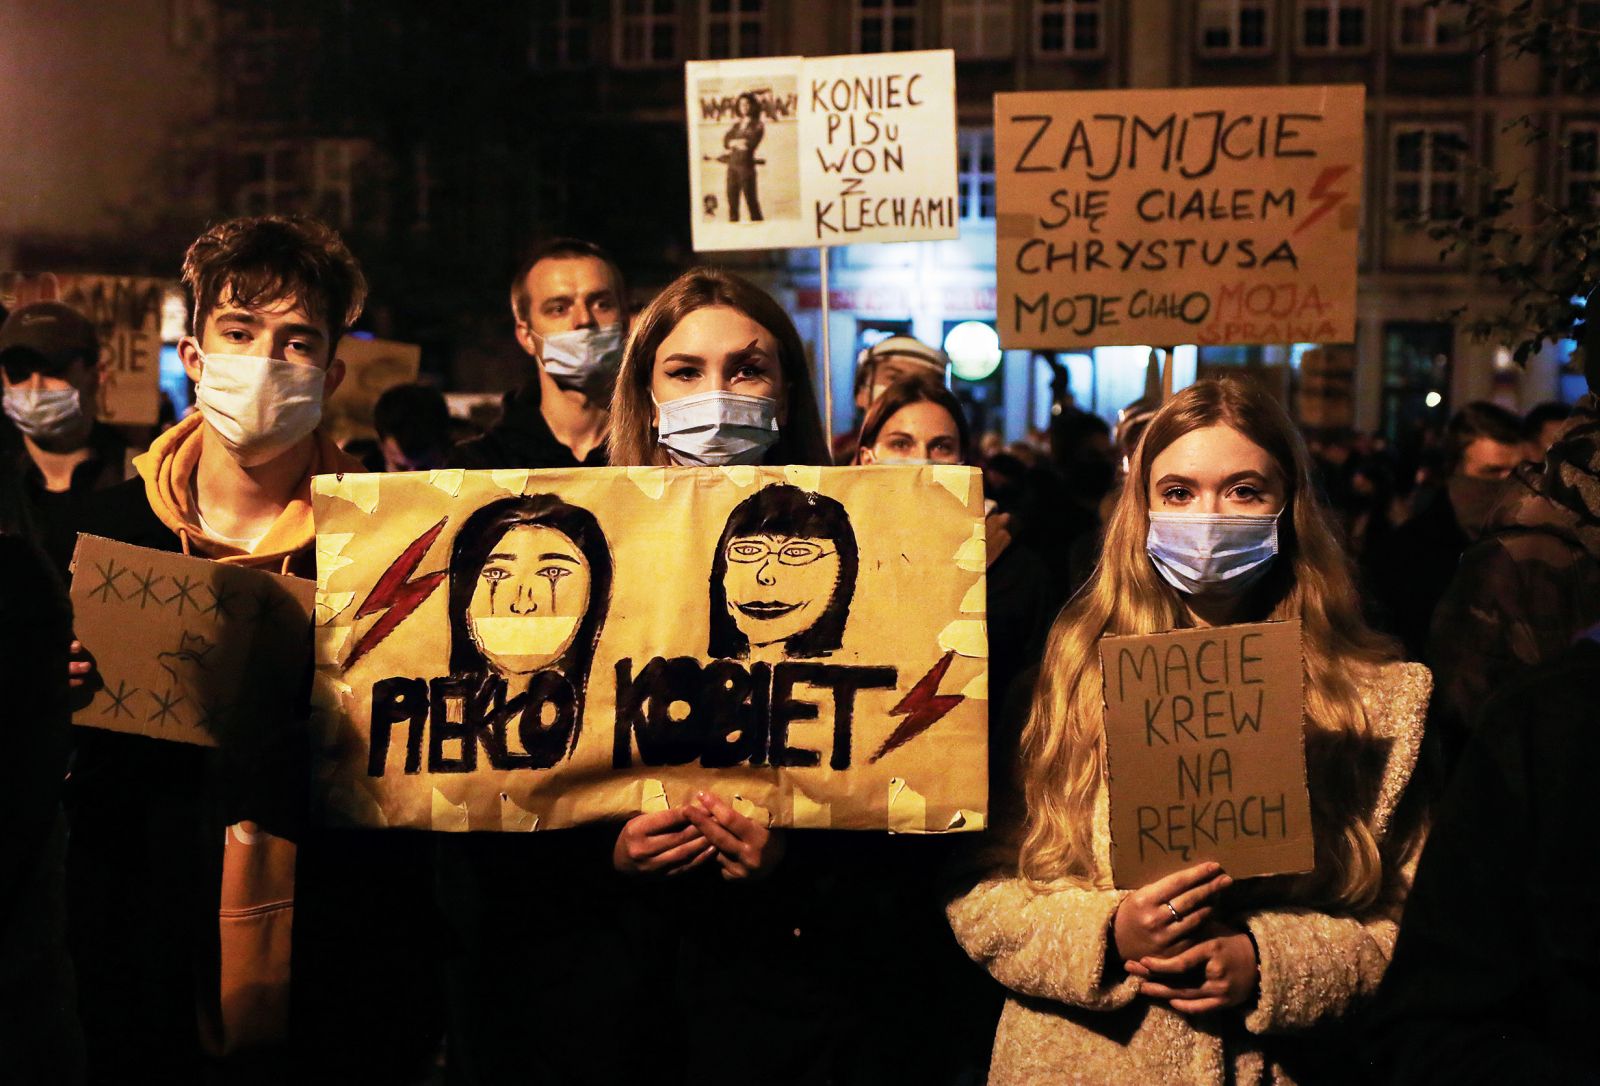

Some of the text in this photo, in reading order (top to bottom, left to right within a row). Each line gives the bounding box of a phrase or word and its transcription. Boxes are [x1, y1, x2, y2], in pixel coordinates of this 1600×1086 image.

[811, 74, 924, 112] KONIEC
[815, 145, 904, 174] WON
[1010, 110, 1324, 181] ZAJMIJCIE
[839, 178, 866, 195] Z
[1039, 188, 1296, 233] SIĘ CIAŁEM
[815, 196, 954, 238] KLECHAMI
[1015, 238, 1299, 275] CHRYSTUSA
[1013, 293, 1122, 336] MOJE
[1214, 281, 1334, 323] MOJA
[1197, 322, 1338, 343] SPRAWA
[1118, 632, 1265, 702] MACIE
[612, 655, 899, 772] KOBIET
[1144, 689, 1264, 747] KREW
[1176, 748, 1233, 800] NA
[1136, 793, 1287, 863] RĘKACH
